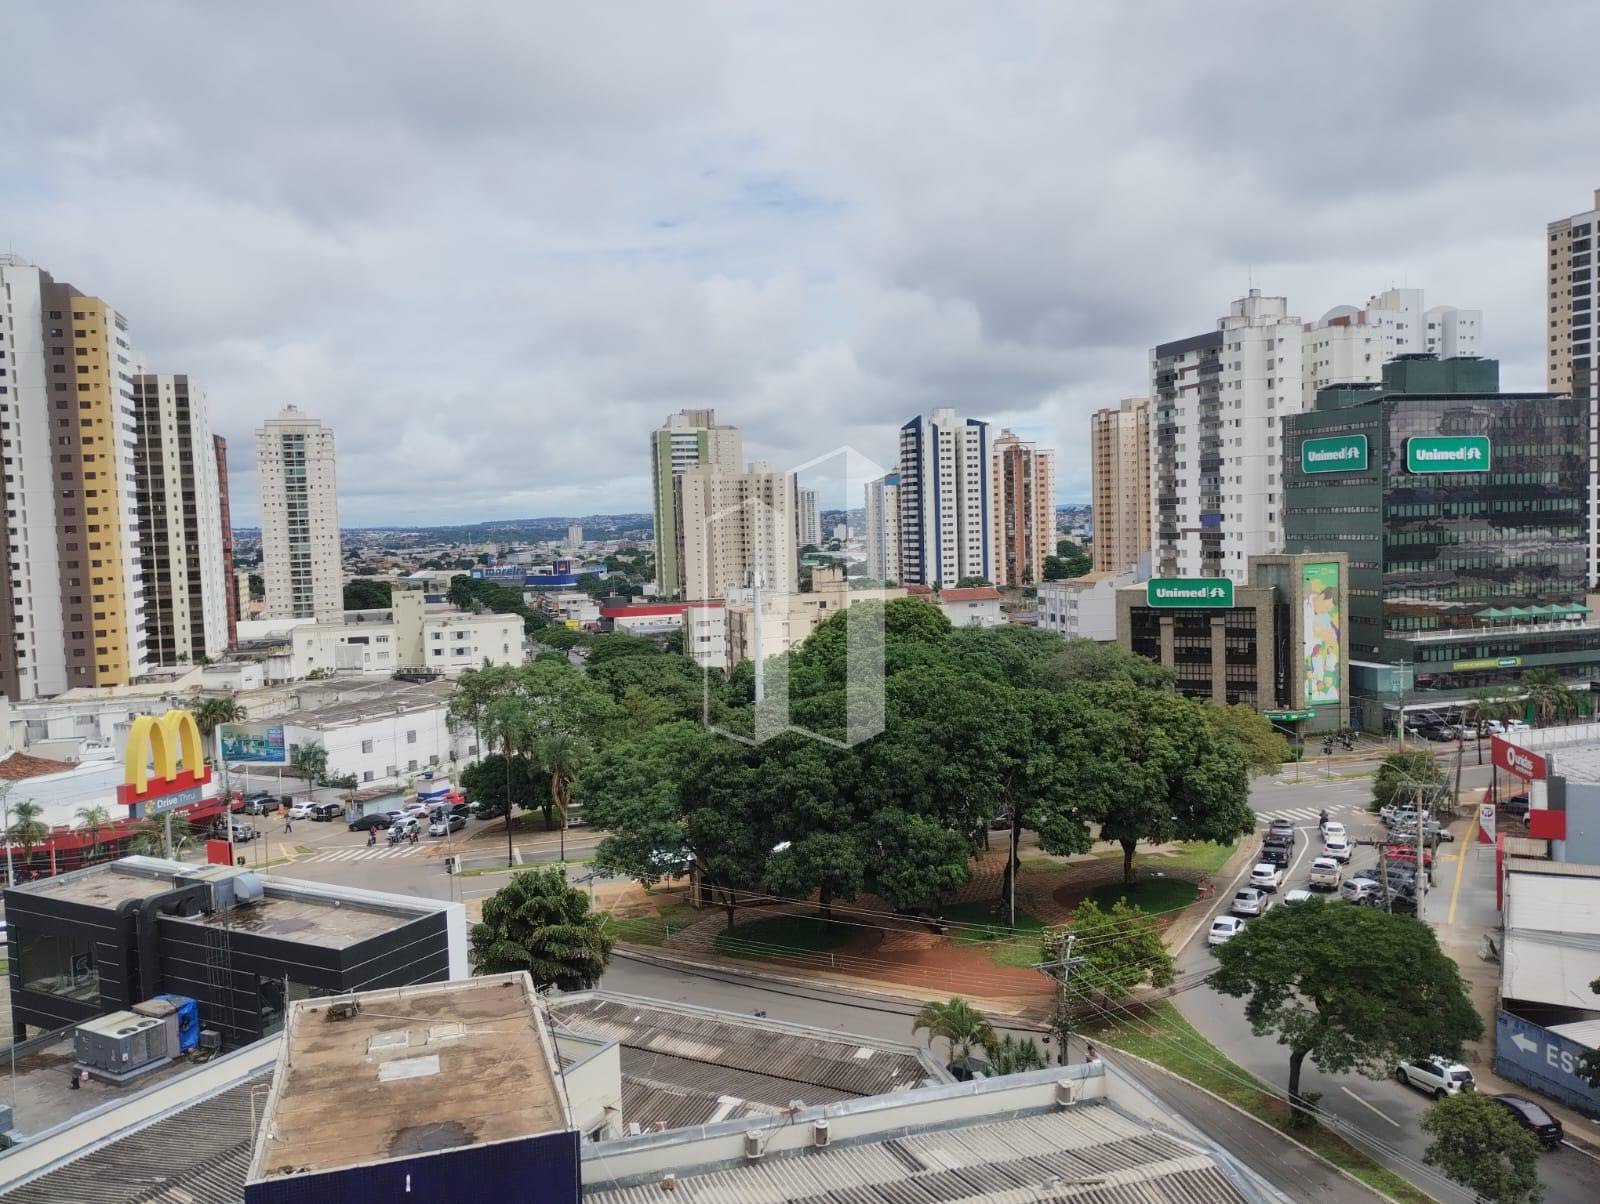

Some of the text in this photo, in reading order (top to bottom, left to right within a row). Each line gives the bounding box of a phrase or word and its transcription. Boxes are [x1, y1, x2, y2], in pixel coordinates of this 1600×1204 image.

[1308, 448, 1346, 461] Unimed
[1416, 448, 1464, 461] Unimed
[1156, 588, 1206, 598] Unimed
[157, 793, 196, 808] Drive Thru
